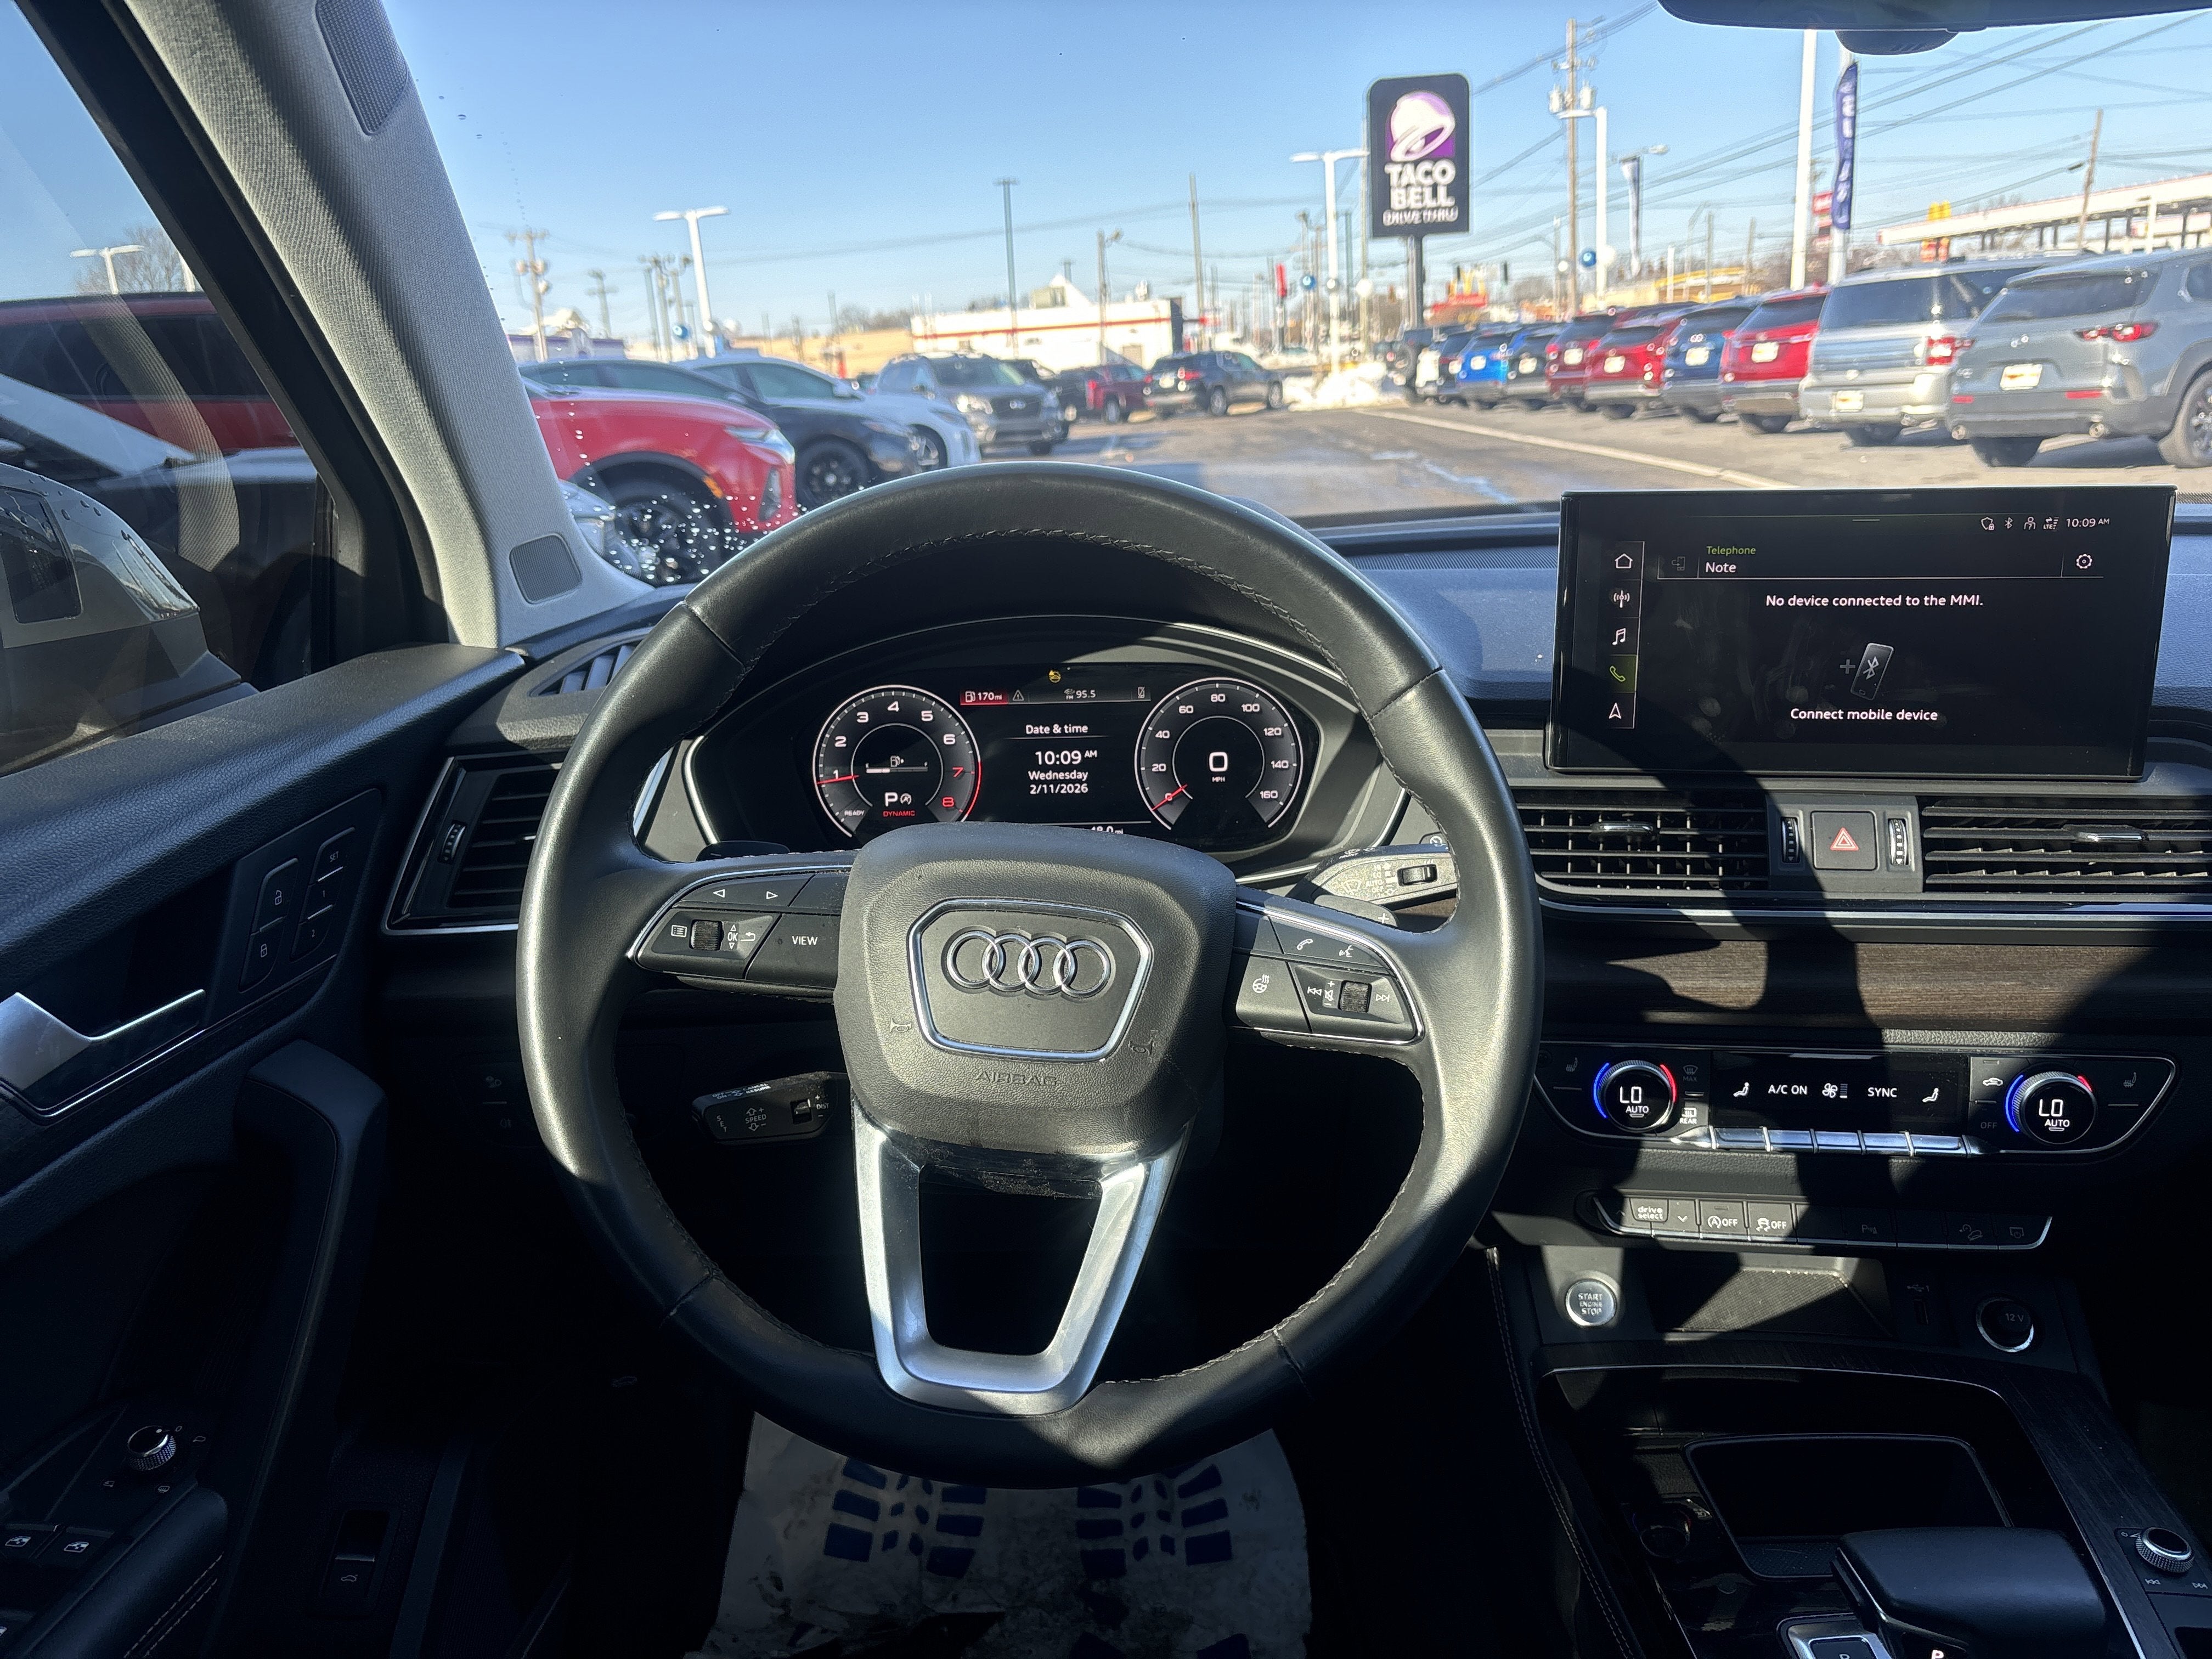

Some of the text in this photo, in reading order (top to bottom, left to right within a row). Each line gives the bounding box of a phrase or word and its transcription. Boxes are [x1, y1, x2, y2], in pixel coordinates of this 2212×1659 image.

[1384, 159, 1456, 187] TACO
[1390, 185, 1455, 210] BELL
[2066, 518, 2096, 527] 10:09
[1706, 545, 1756, 557] Telephone
[1706, 562, 1736, 573] Note
[1766, 595, 1984, 606] No device connected to the MMI.
[1076, 690, 1096, 698] 95.5
[1210, 693, 1226, 702] 80
[887, 701, 900, 712] 4
[1178, 705, 1194, 714] 60
[1241, 703, 1260, 712] 100
[856, 712, 869, 723] 3
[921, 710, 933, 721] 5
[1790, 708, 1938, 720] Connect mobile device
[1025, 723, 1088, 734] Date & time
[1263, 727, 1282, 736] 120
[943, 733, 956, 745] 6
[1155, 730, 1170, 739] 40
[834, 736, 847, 747] 2
[1035, 750, 1097, 765] 10:09 AM
[1209, 752, 1228, 772] 0
[1152, 763, 1166, 772] 20
[1271, 760, 1289, 769] 140
[952, 767, 964, 778] 7
[1028, 770, 1088, 781] Wednesday
[1030, 783, 1088, 794] 2/11/2026
[885, 792, 898, 806] P
[1260, 790, 1278, 799] 160
[942, 797, 955, 807] 8
[727, 932, 738, 941] OK
[792, 936, 818, 946] VIEW
[975, 1070, 1057, 1087] AIRBAG
[1620, 1086, 1642, 1104] LO
[1768, 1084, 1808, 1095] A/C ON
[1867, 1087, 1898, 1098] SYNC
[1626, 1105, 1649, 1114] AUTO
[2039, 1099, 2063, 1117] LO
[745, 1114, 767, 1124] SPEED
[2045, 1119, 2070, 1127] AUTO
[1980, 1121, 1997, 1130] OFF
[1722, 1217, 1738, 1227] OFF
[1771, 1220, 1787, 1229] OFF
[1578, 1292, 1603, 1301] START
[1581, 1308, 1602, 1316] STOP
